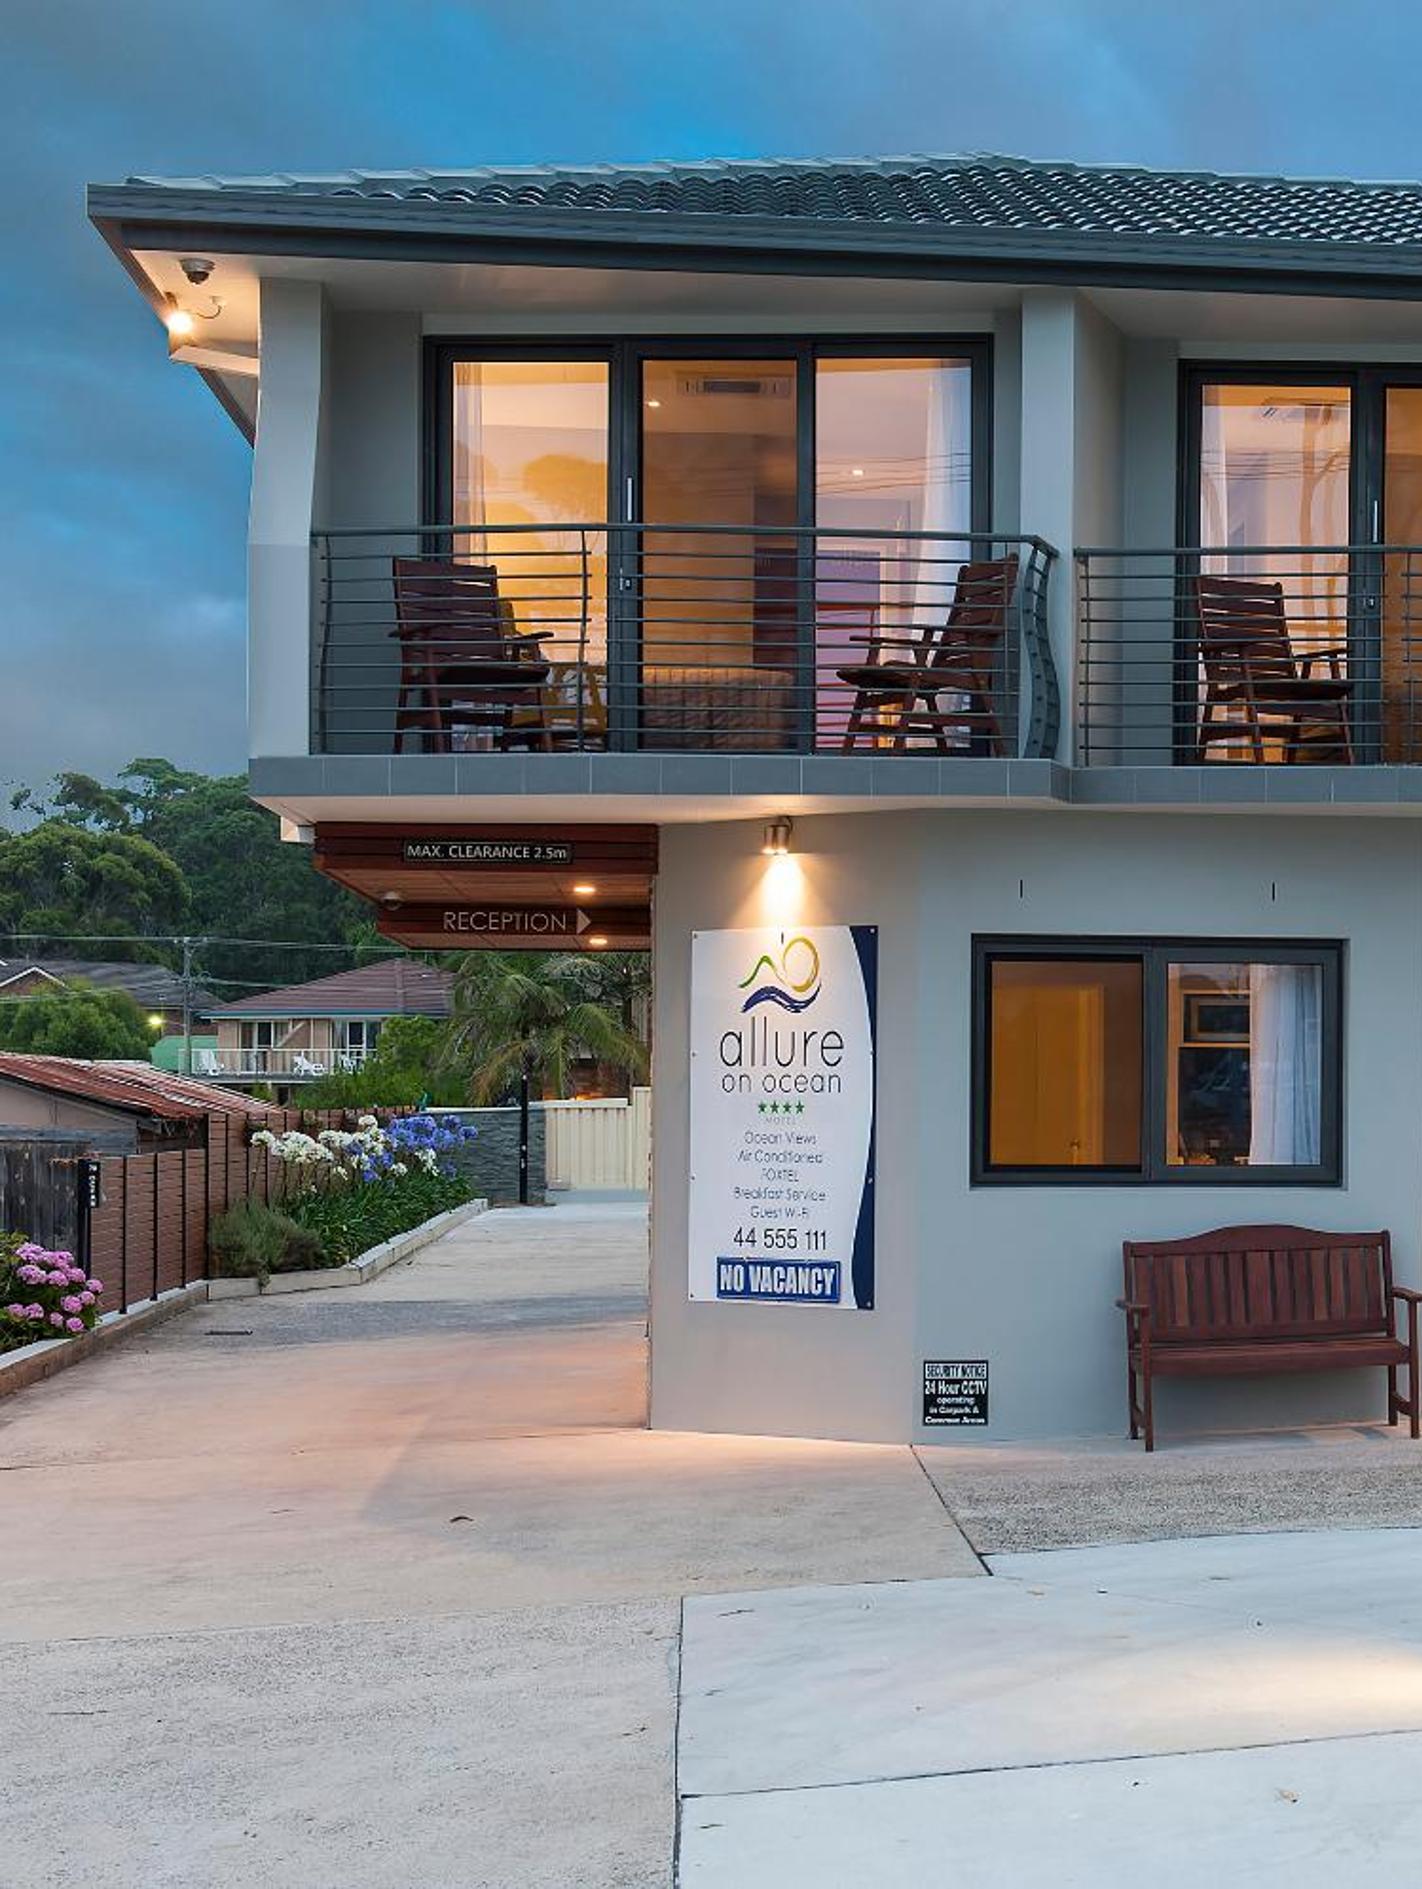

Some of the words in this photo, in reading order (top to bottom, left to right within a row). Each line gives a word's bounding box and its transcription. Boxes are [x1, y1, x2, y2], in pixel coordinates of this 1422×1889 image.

[407, 844, 444, 859] MAX.
[448, 844, 530, 860] CLEARANCE
[534, 846, 567, 861] 2.5m
[443, 911, 567, 932] RECEPTION
[720, 1016, 844, 1067] allure
[722, 1074, 751, 1093] on
[762, 1074, 841, 1093] ocean
[744, 1131, 781, 1144] Ocean
[785, 1132, 817, 1145] Views
[737, 1150, 753, 1162] Air
[755, 1149, 824, 1164] Conditioned
[734, 1186, 784, 1200] Breakfast
[786, 1188, 826, 1201] Service
[750, 1206, 783, 1219] Guest
[733, 1227, 757, 1247] 44
[763, 1229, 798, 1249] 555
[805, 1230, 827, 1250] 111
[720, 1264, 744, 1291] NO
[748, 1265, 836, 1295] VACANCY
[925, 1380, 936, 1395] 24
[938, 1380, 960, 1395] Hour
[961, 1380, 987, 1395] CCTV
